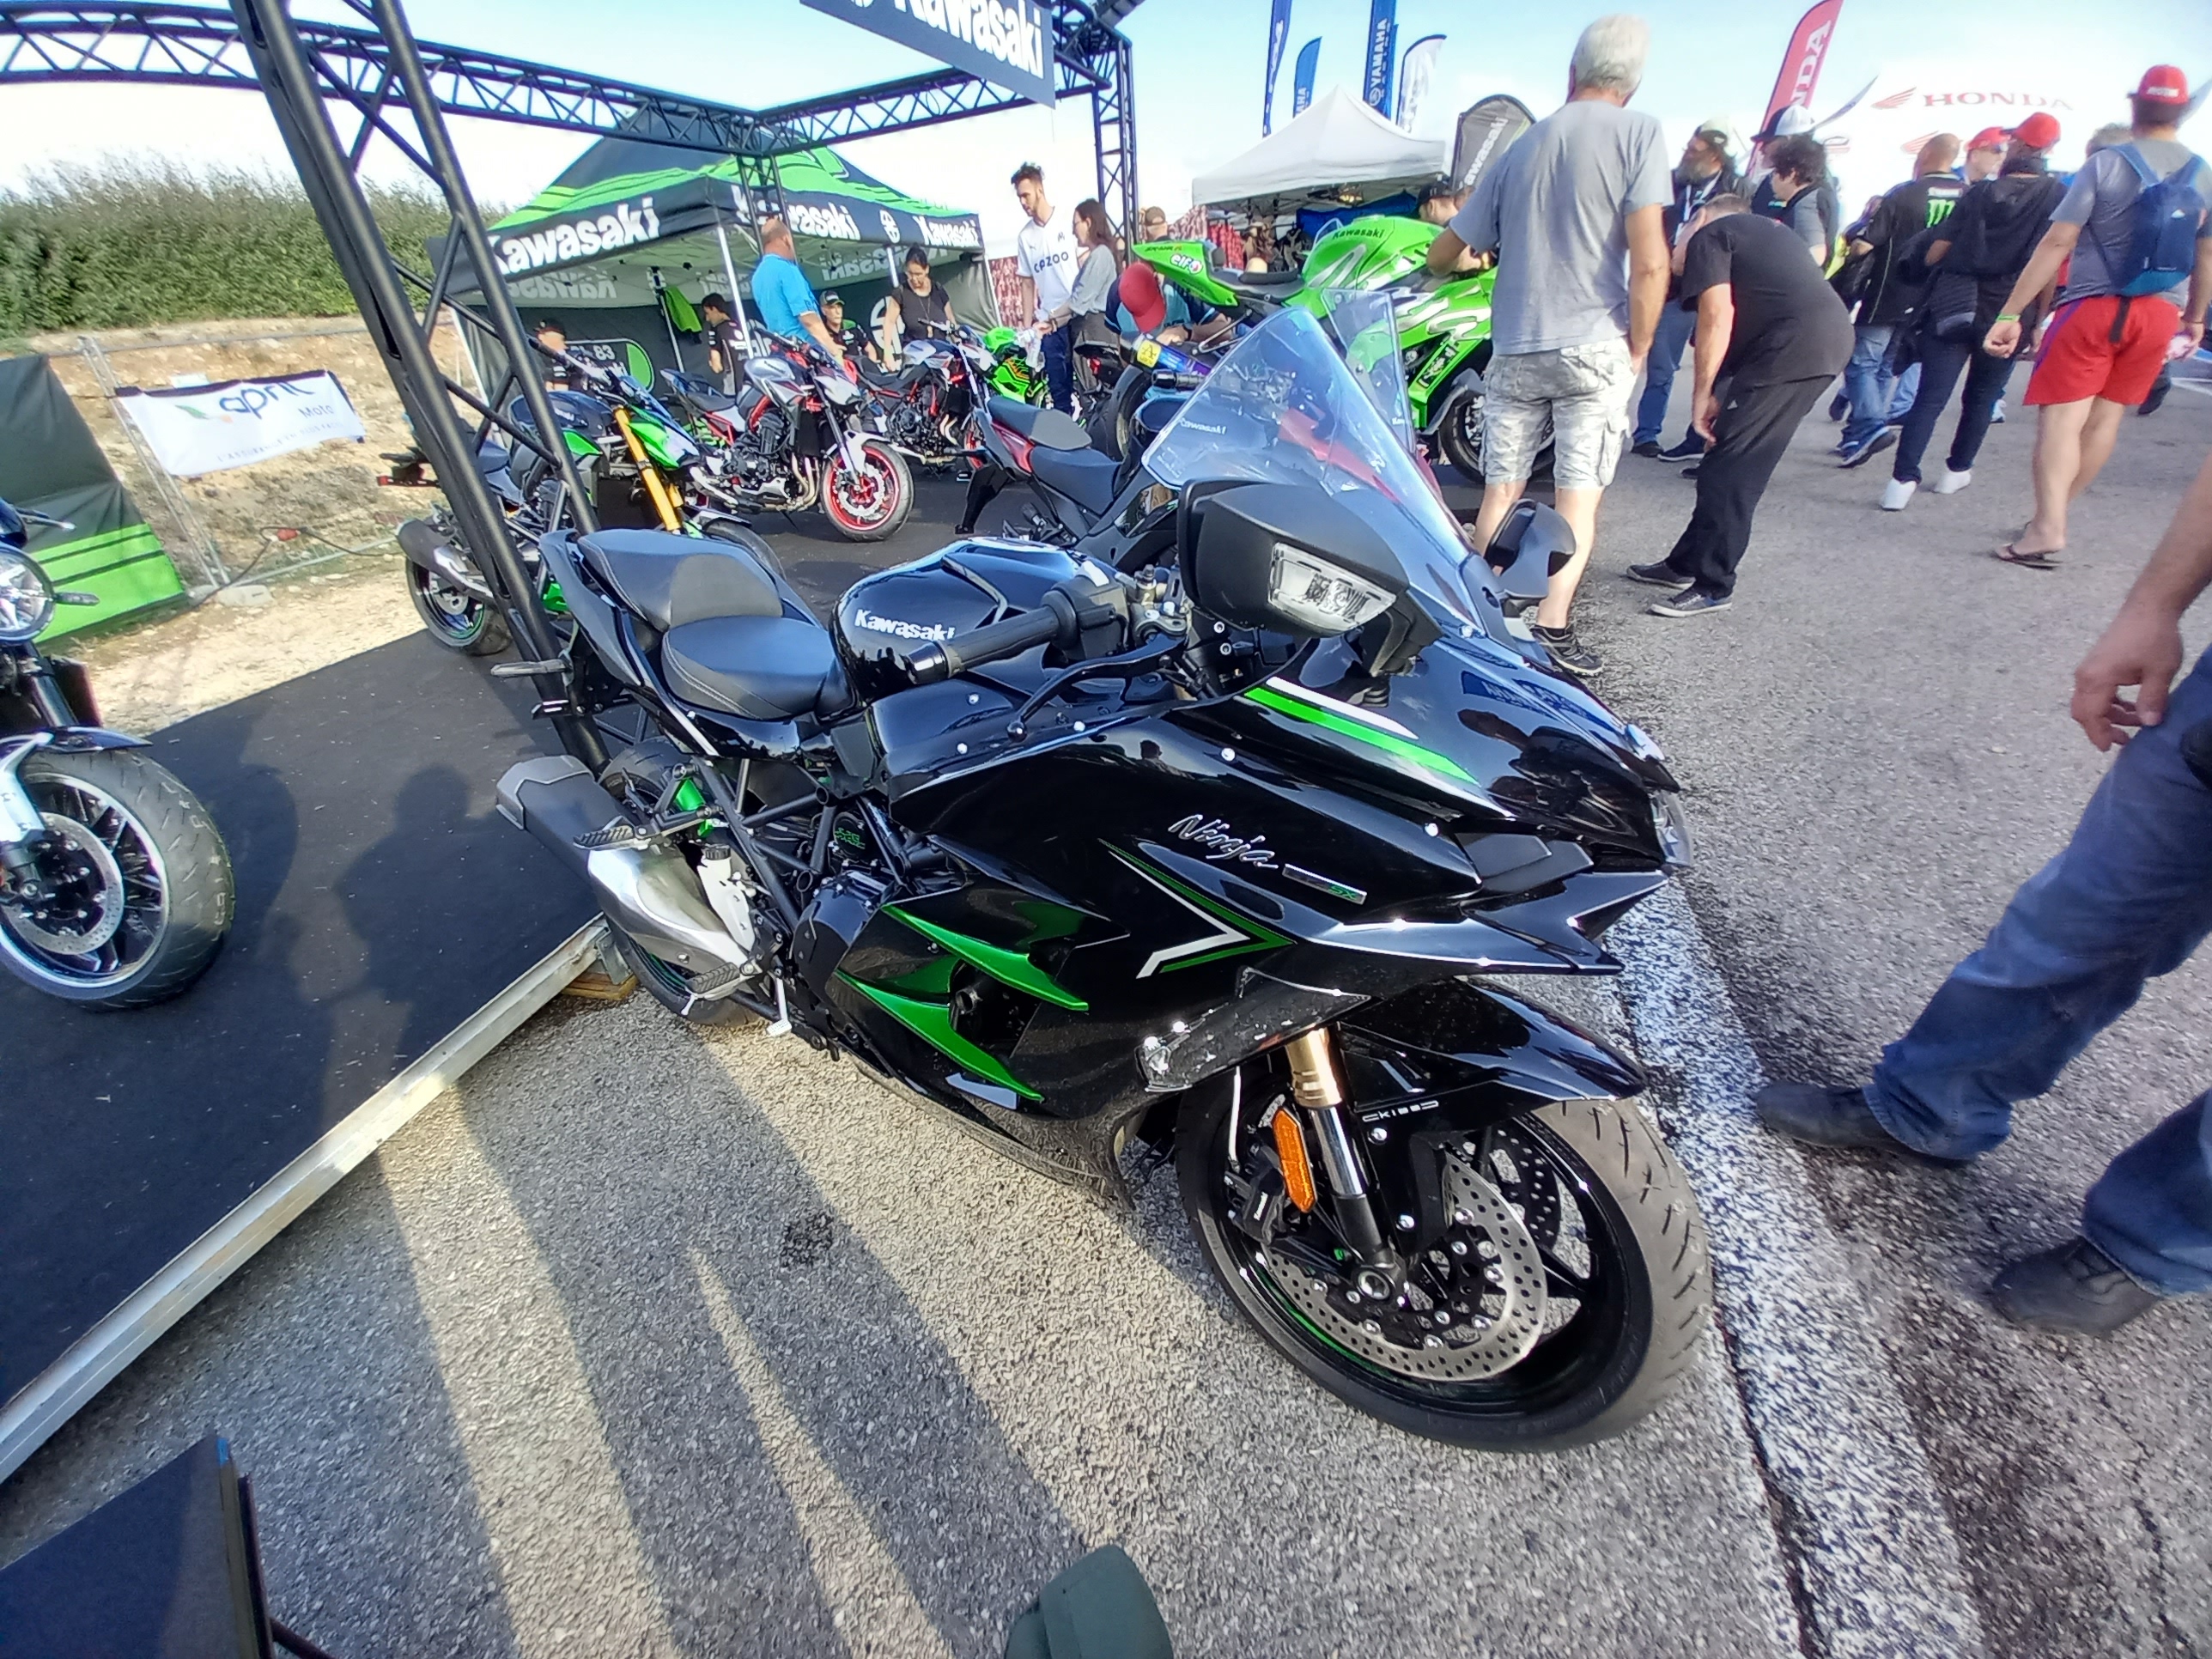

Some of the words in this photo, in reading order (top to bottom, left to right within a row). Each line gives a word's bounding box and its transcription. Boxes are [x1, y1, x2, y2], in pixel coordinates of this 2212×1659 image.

[894, 0, 1044, 79] awasaki
[1370, 18, 1388, 87] YAMAHA
[1790, 20, 1831, 106] NDA
[1923, 92, 2074, 111] HONDA
[913, 215, 982, 247] Kawasaki
[1333, 227, 1385, 240] Kawasaki
[592, 344, 616, 361] 83
[298, 404, 335, 419] Moto
[854, 609, 956, 641] Kawasaki
[1168, 814, 1279, 870] Ninja
